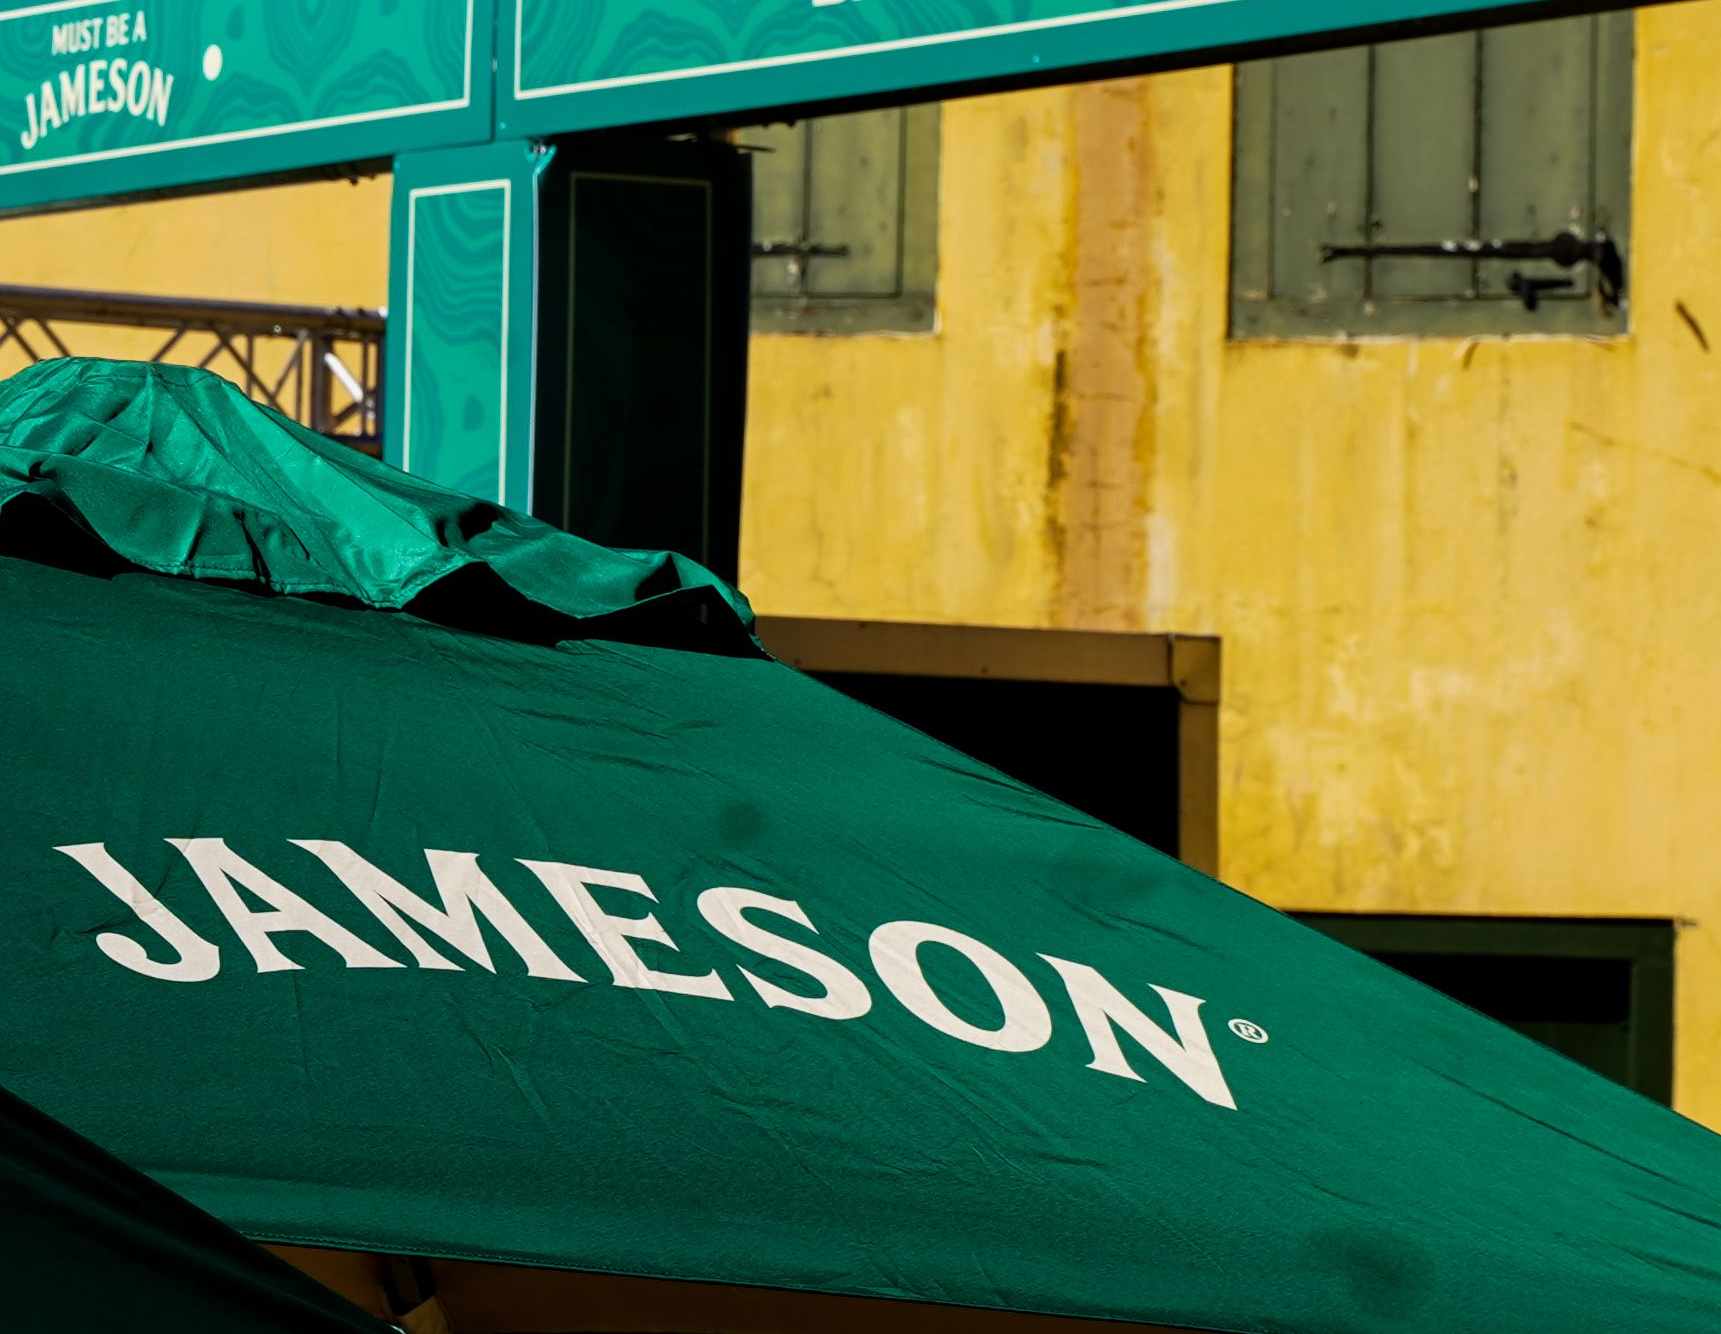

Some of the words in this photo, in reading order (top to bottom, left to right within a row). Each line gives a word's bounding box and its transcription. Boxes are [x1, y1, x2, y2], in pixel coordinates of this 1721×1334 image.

[51, 17, 103, 56] MUST
[105, 13, 130, 47] BE
[131, 10, 147, 42] A
[20, 57, 174, 149] JAMESON
